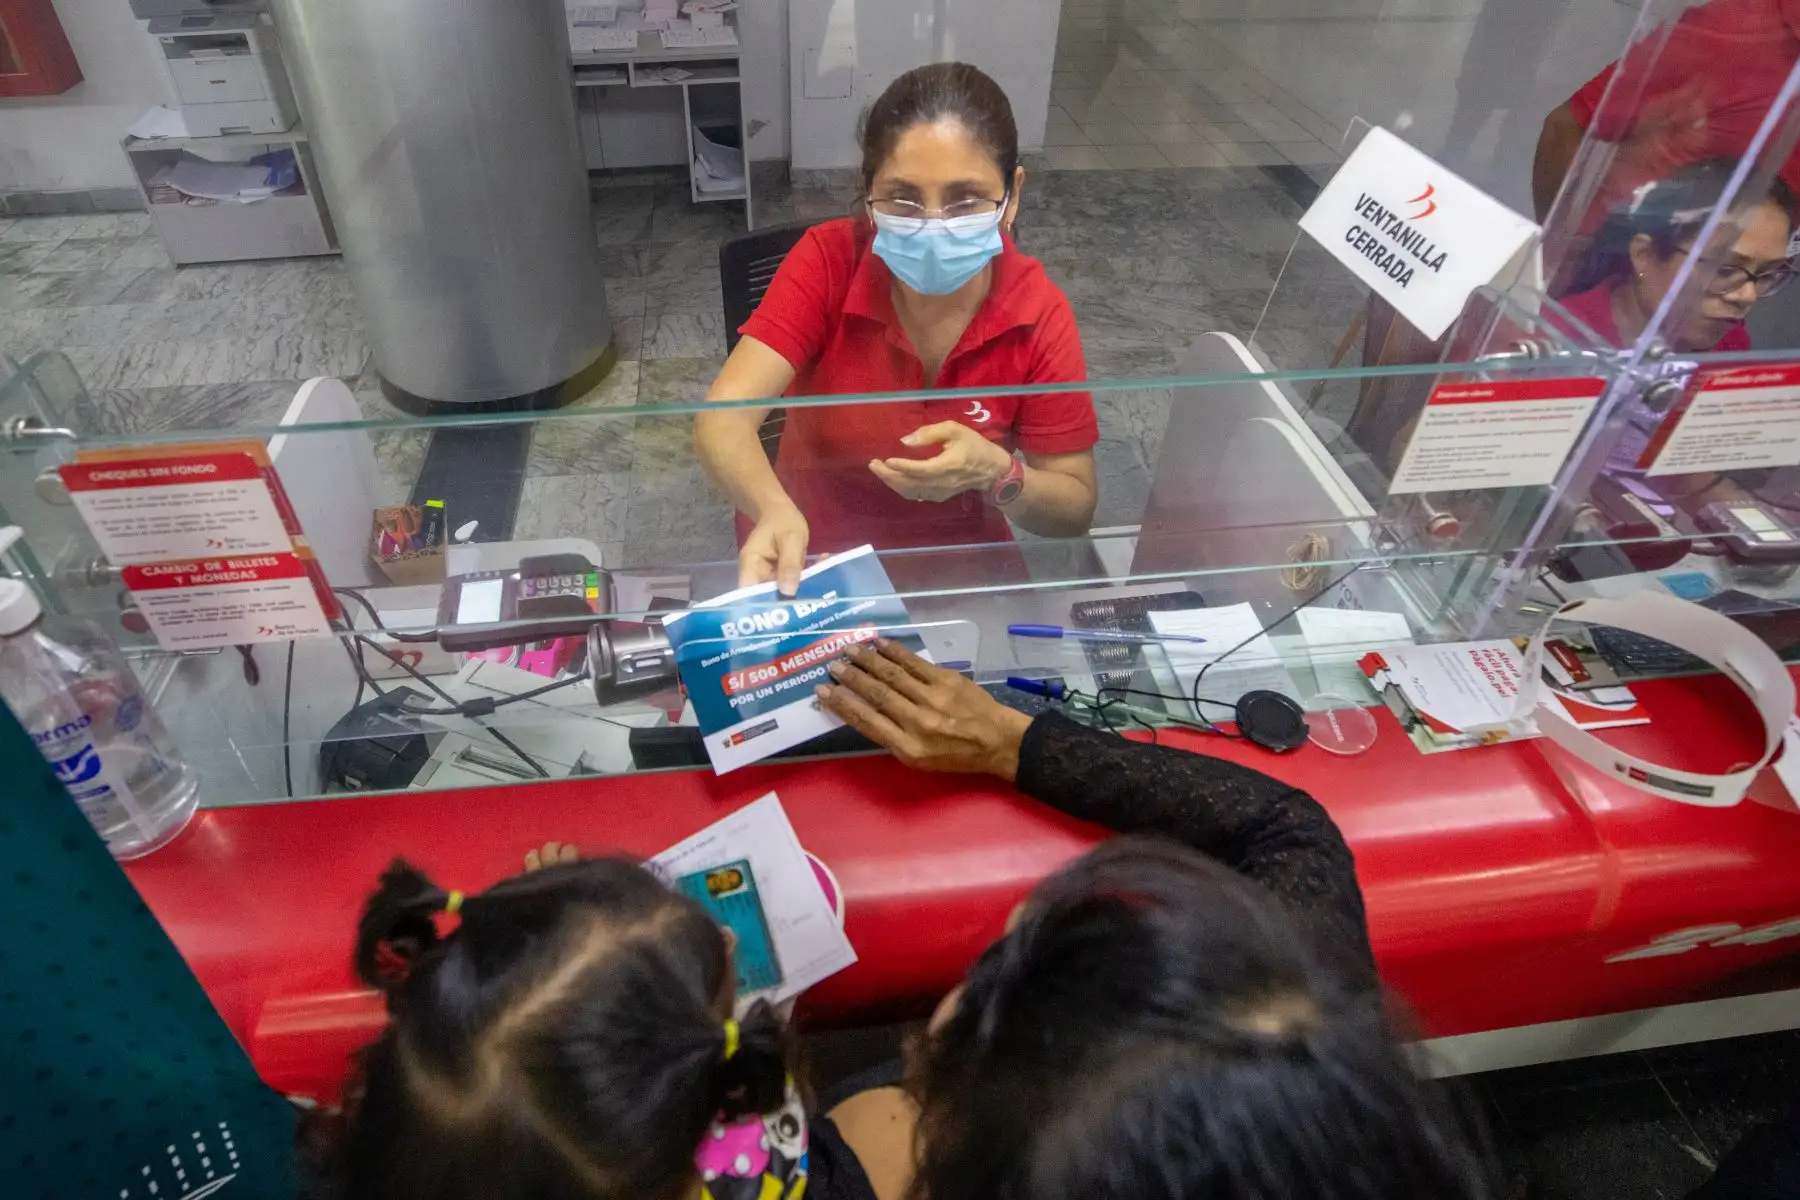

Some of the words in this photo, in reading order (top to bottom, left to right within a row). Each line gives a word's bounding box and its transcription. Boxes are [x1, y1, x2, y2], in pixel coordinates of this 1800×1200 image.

[1354, 192, 1448, 273] VENTANILLA
[1345, 225, 1415, 289] CERRADA
[89, 468, 148, 481] CHEQUES
[148, 466, 170, 477] SIN
[170, 463, 218, 476] FONDO
[140, 563, 199, 577] CAMBIO
[203, 561, 222, 572] DE
[226, 556, 280, 570] BILLETES
[173, 575, 183, 585] Y
[189, 568, 258, 585] MONEDAS
[720, 607, 790, 640] BONO
[701, 655, 721, 668] Bono
[727, 671, 746, 690] S/
[748, 665, 779, 685] 500
[780, 628, 875, 673] MENSUALES
[729, 692, 756, 709] POR
[755, 685, 774, 699] UN
[775, 667, 826, 692] PERIODO
